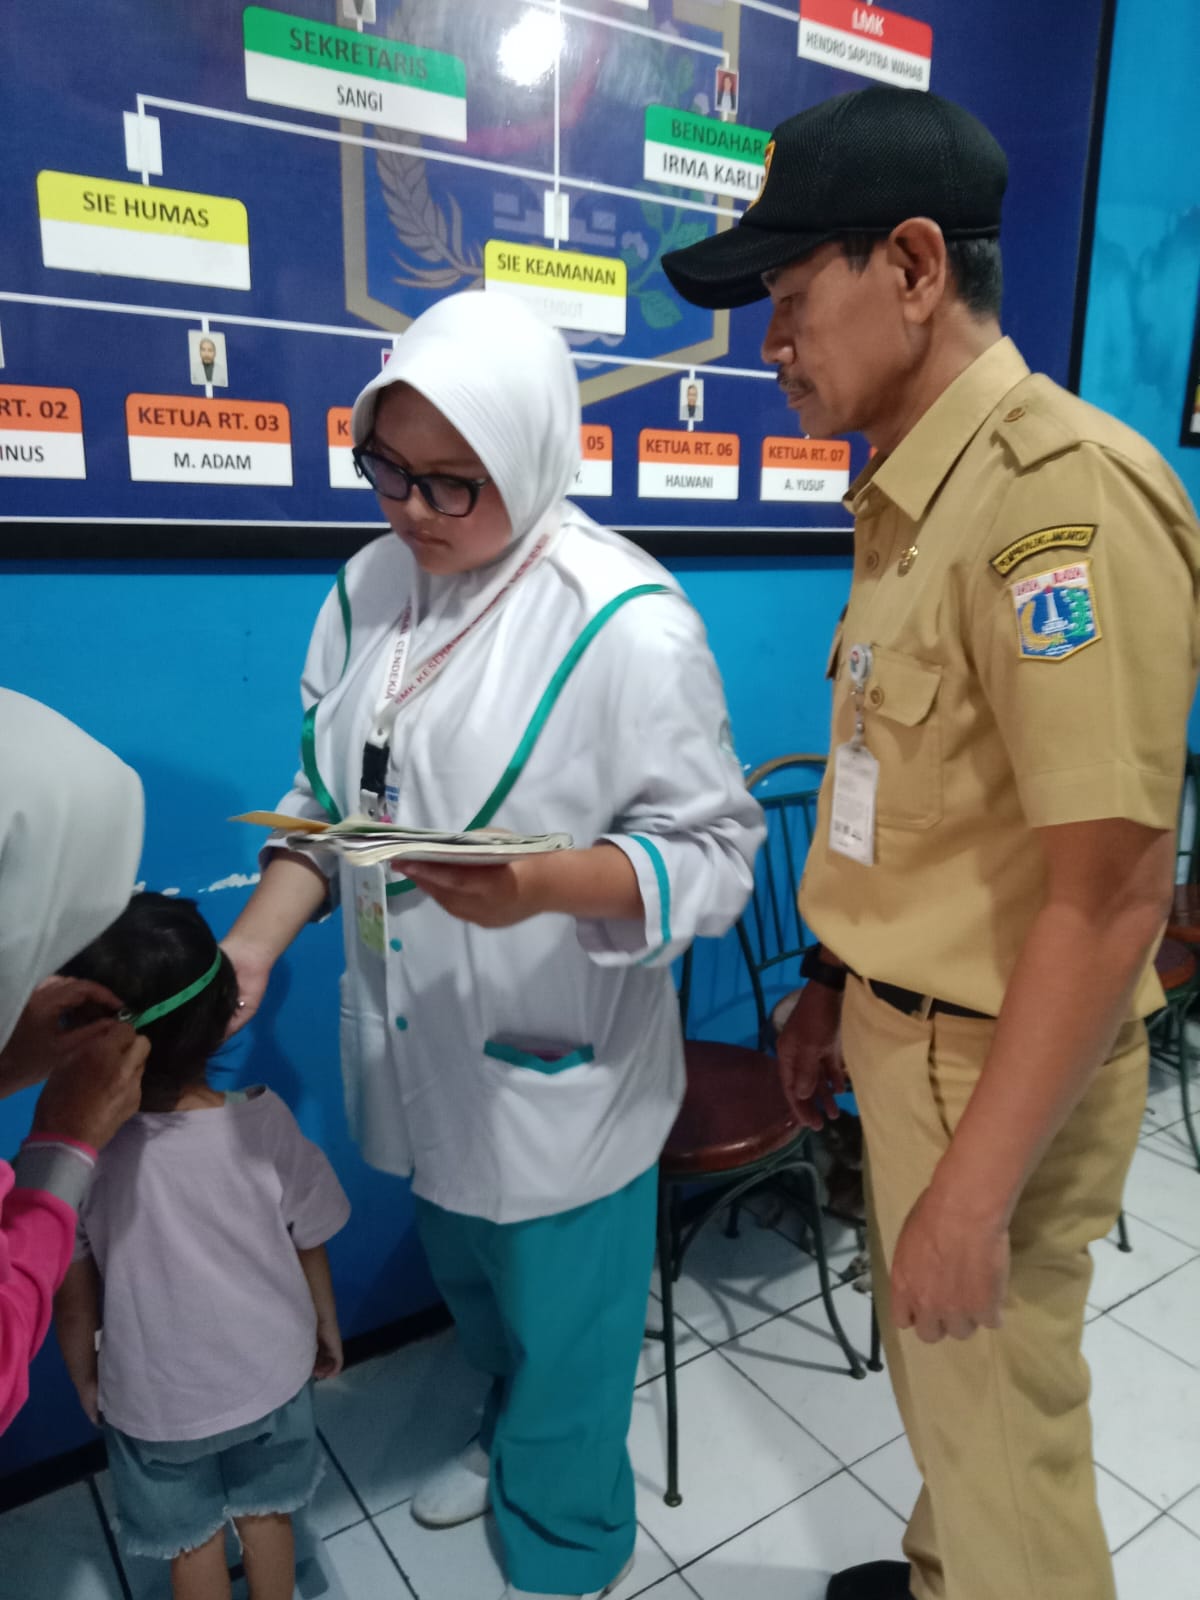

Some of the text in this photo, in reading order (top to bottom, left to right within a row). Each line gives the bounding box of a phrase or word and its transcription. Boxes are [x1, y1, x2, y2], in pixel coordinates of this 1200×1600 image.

[852, 8, 884, 36] LMK
[289, 27, 428, 80] SEKRETARIS
[806, 31, 923, 82] HENDRO SAPUTRA WAHAB
[337, 85, 383, 112] SANGI
[664, 152, 710, 181] IRMA
[83, 191, 210, 228] SIE HUMAS
[497, 253, 617, 285] SIE KEAMANAN
[0, 399, 69, 420] RT. 02
[138, 406, 280, 431] KETUA RT. 03
[586, 436, 605, 451] 05
[646, 438, 733, 457] KETUA RT. 06
[769, 446, 845, 462] KETUA RT. 07
[174, 452, 252, 471] M. ADAM
[666, 474, 714, 489] HALWANI
[784, 478, 825, 492] A. YUSUF
[384, 640, 405, 699] CENDEKIA
